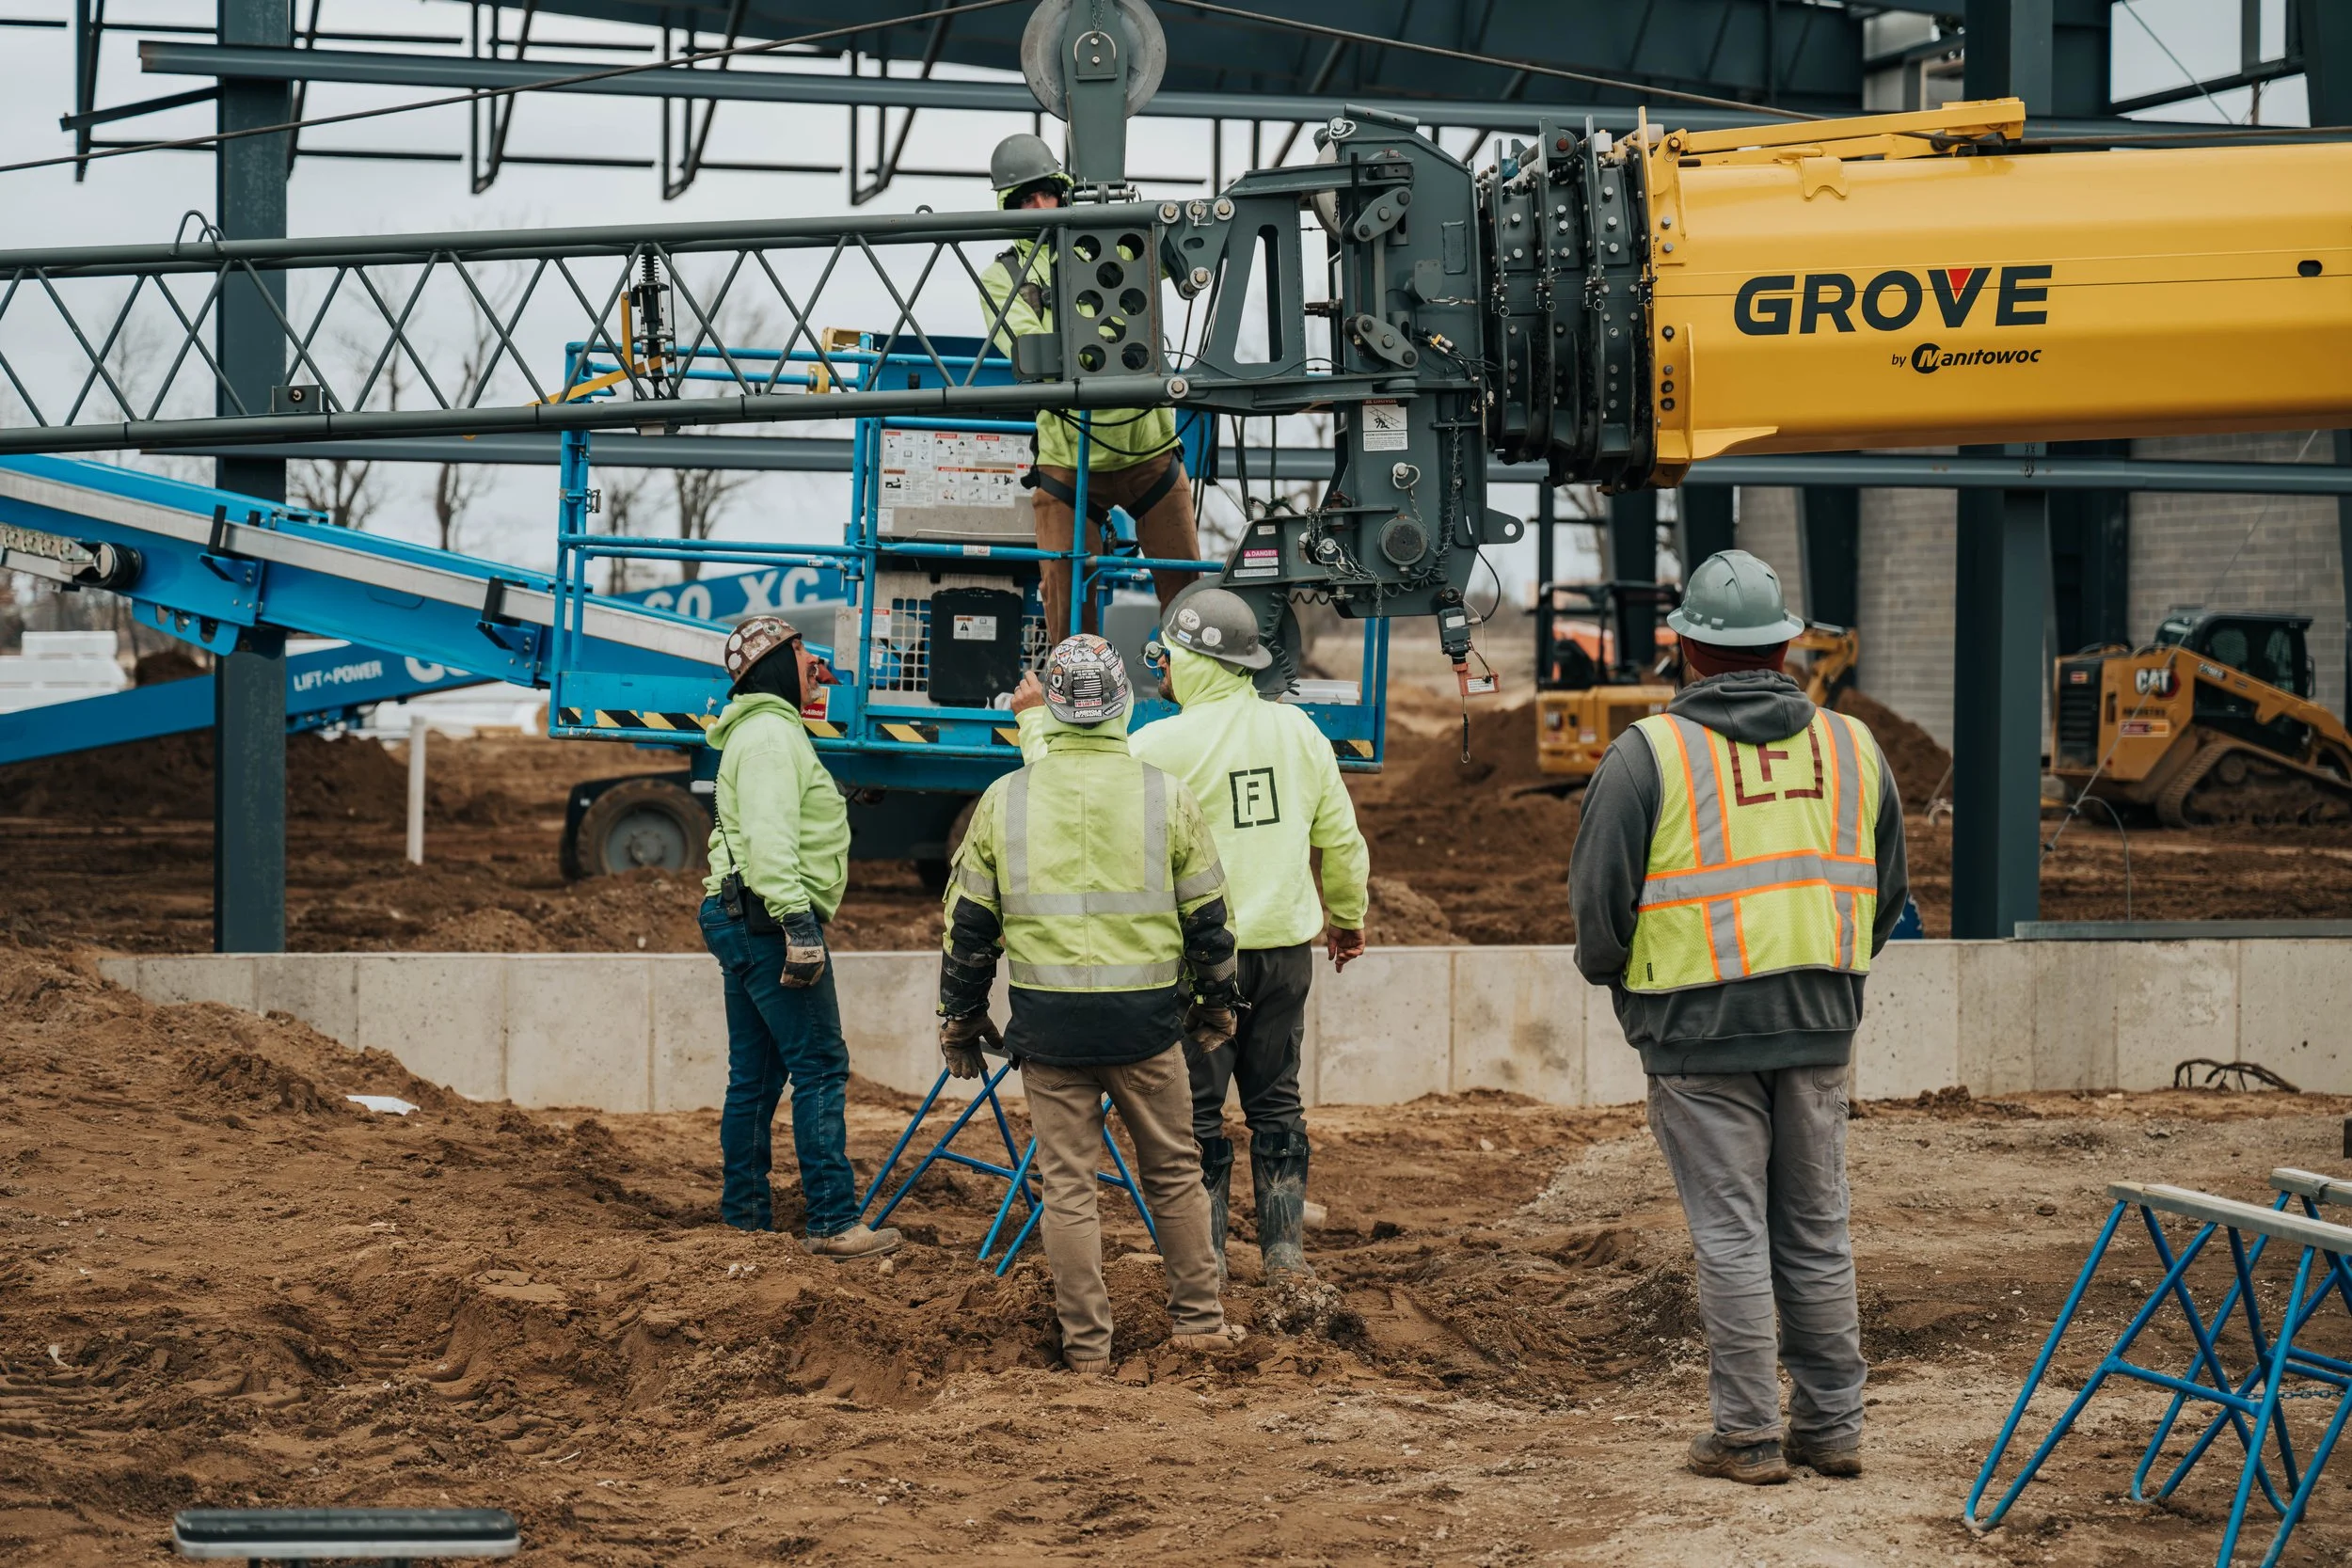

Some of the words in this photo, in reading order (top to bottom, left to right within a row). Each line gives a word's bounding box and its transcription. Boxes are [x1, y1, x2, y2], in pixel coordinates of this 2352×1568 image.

[1734, 264, 2053, 336] GROVE
[1891, 354, 1907, 368] by
[1911, 342, 2042, 374] Manitowoc
[332, 659, 383, 686] POWER
[2136, 669, 2170, 694] CAT
